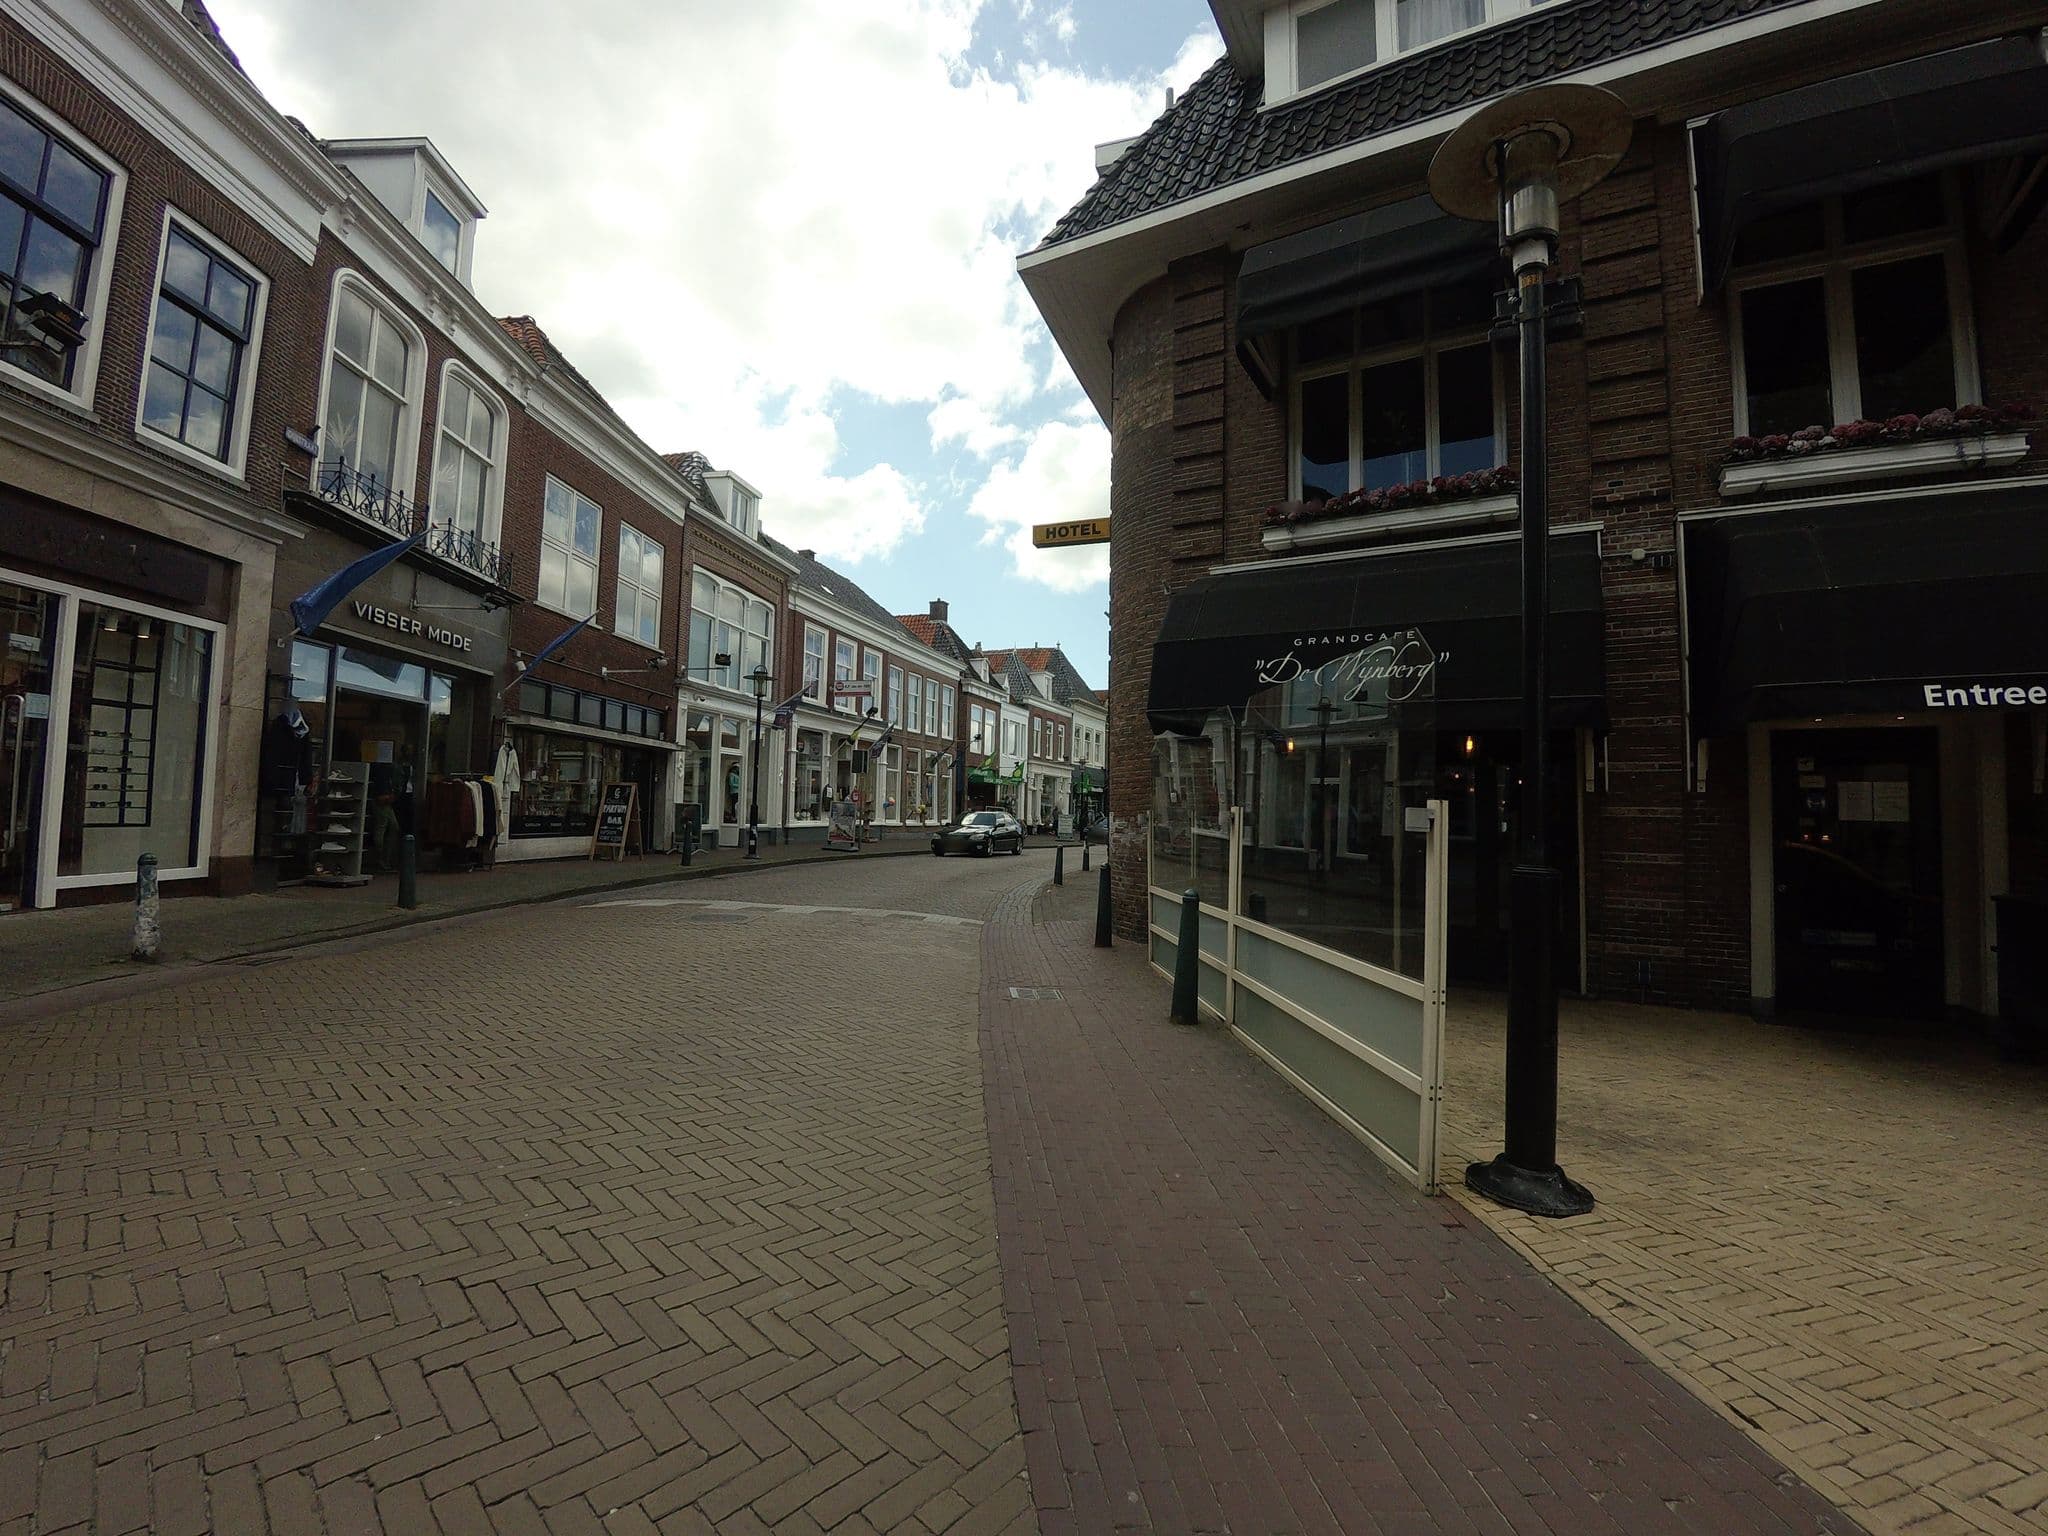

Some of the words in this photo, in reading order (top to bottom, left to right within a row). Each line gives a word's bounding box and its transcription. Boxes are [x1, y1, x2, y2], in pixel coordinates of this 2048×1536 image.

[1045, 522, 1102, 540] HOTEL
[353, 600, 422, 636] VISSER
[427, 624, 473, 652] MODE
[1293, 630, 1417, 647] GRANDCAFE
[1923, 684, 2048, 707] Entree
